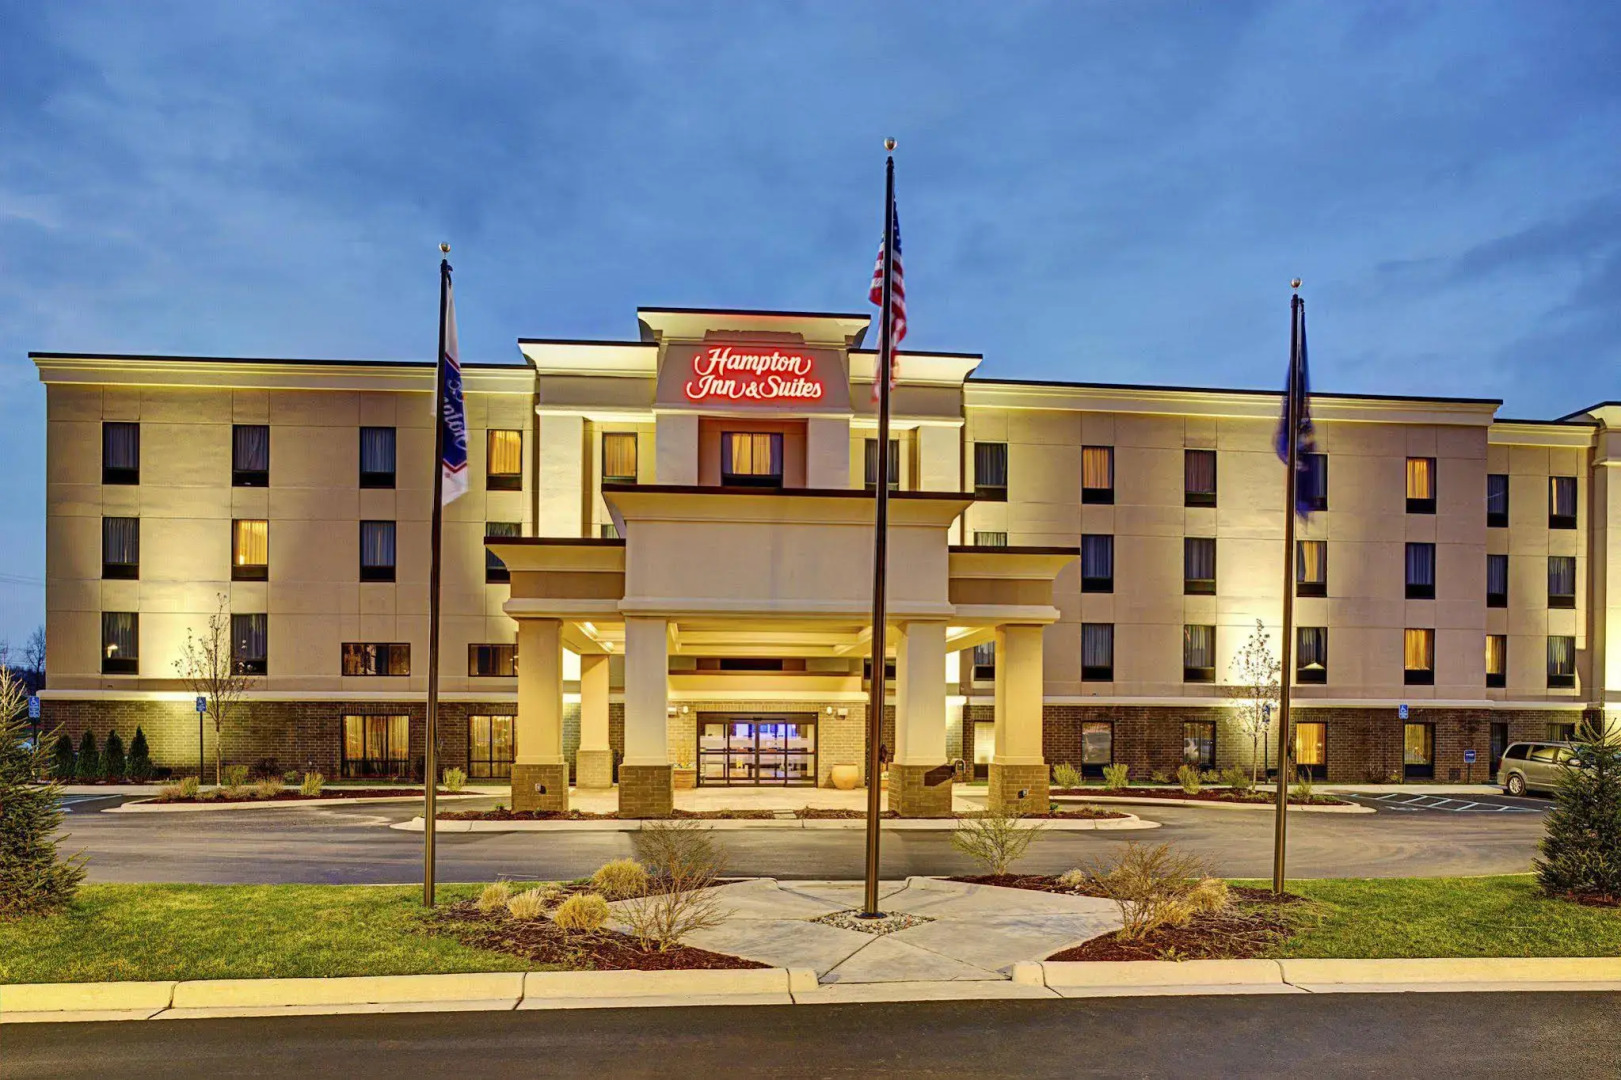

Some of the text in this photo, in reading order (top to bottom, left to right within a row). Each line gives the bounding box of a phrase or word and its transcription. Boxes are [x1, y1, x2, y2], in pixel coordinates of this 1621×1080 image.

[694, 347, 812, 376] Hampton
[686, 375, 822, 399] Inn & Suites
